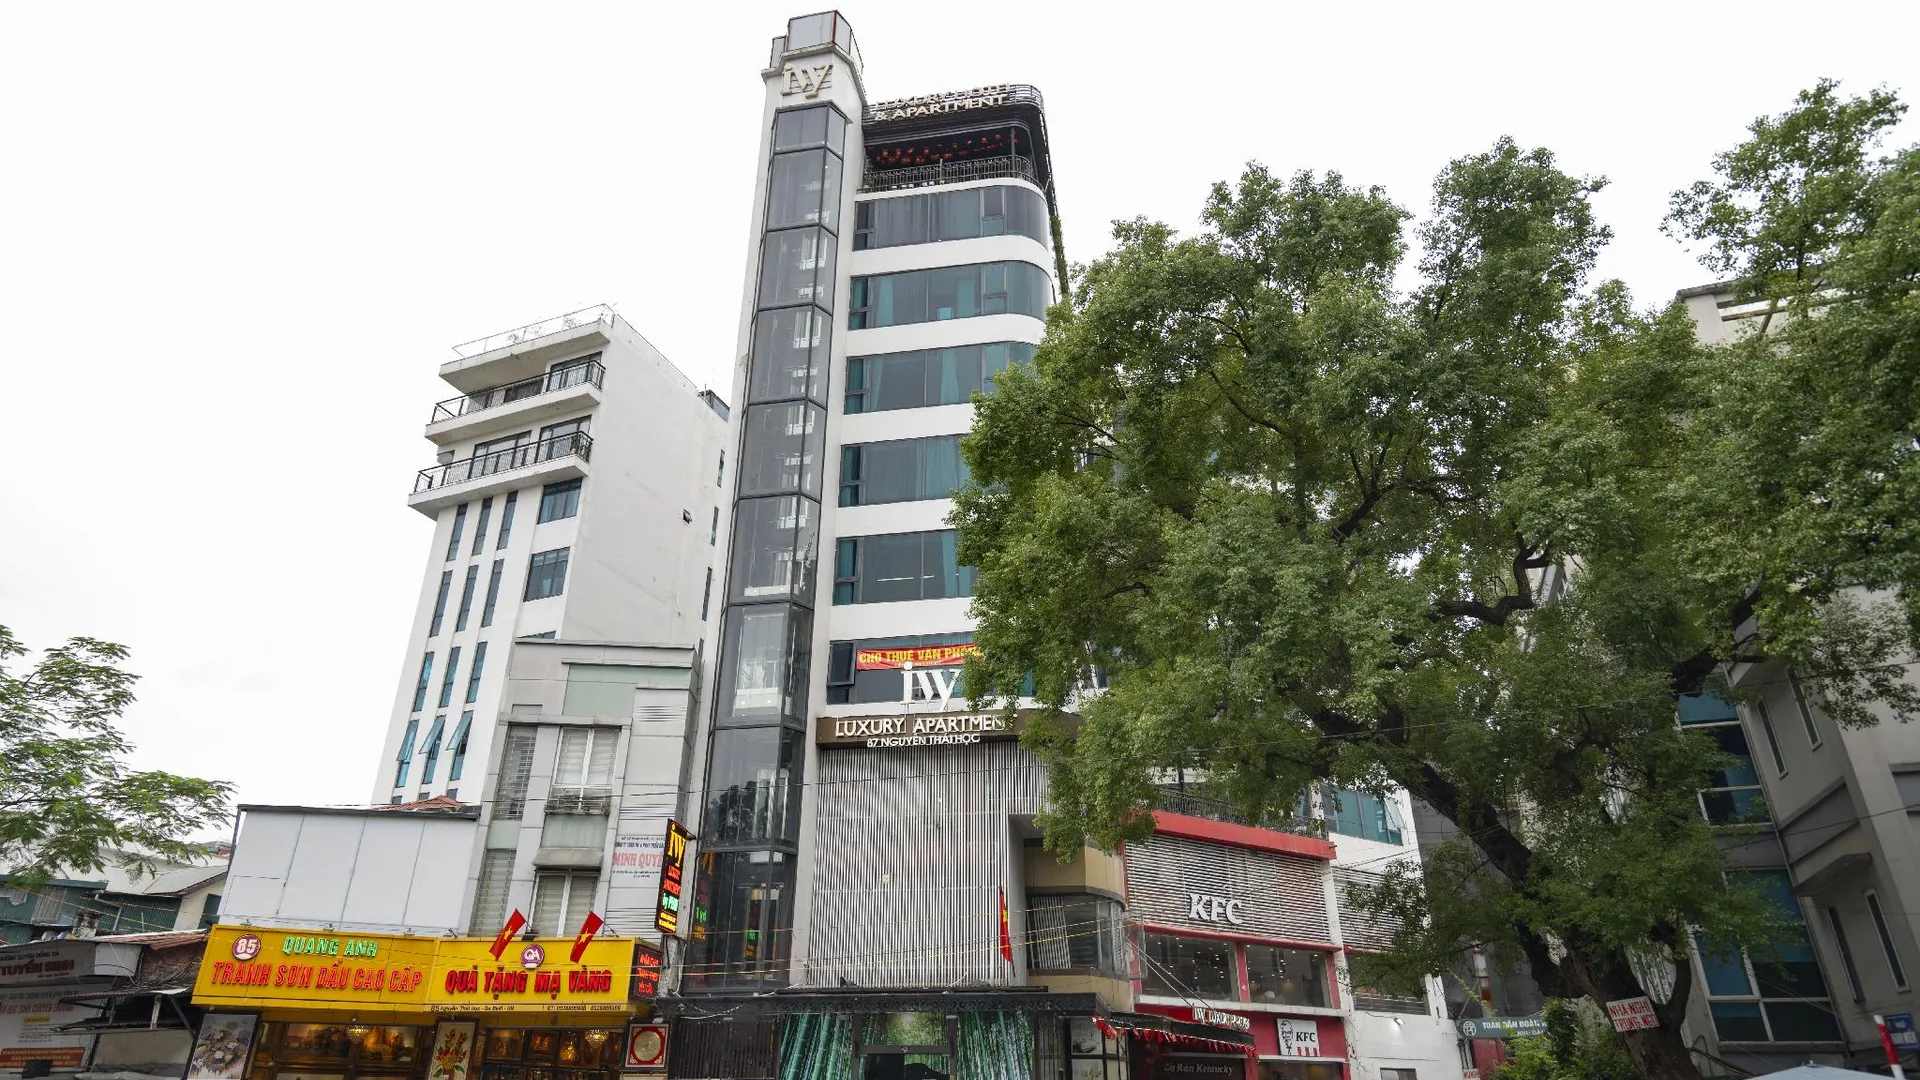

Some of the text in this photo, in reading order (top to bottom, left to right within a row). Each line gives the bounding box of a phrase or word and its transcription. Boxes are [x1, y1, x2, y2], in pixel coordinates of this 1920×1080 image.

[875, 82, 1012, 111] LUXURY HOTEL
[875, 94, 1008, 121] & APARTMENT
[859, 652, 882, 663] CHO
[886, 650, 914, 662] THUÊ
[835, 714, 1016, 737] LUXURY APARTMEN
[866, 737, 878, 748] 87
[928, 732, 953, 745] THÁI
[954, 733, 980, 746] HỌC
[1189, 893, 1243, 924] KFC
[236, 938, 257, 954] 85
[282, 936, 379, 957] QUANG ANH
[211, 961, 272, 985] TRANH
[275, 962, 313, 988] SƠN
[353, 967, 386, 990] CAO
[388, 962, 422, 992] CẤP
[484, 965, 528, 1000] TẶNG
[534, 970, 561, 1000] MẠ
[569, 965, 612, 993] VÀNG
[1296, 1031, 1316, 1043] KFC
[1196, 1063, 1233, 1076] Kentucky
